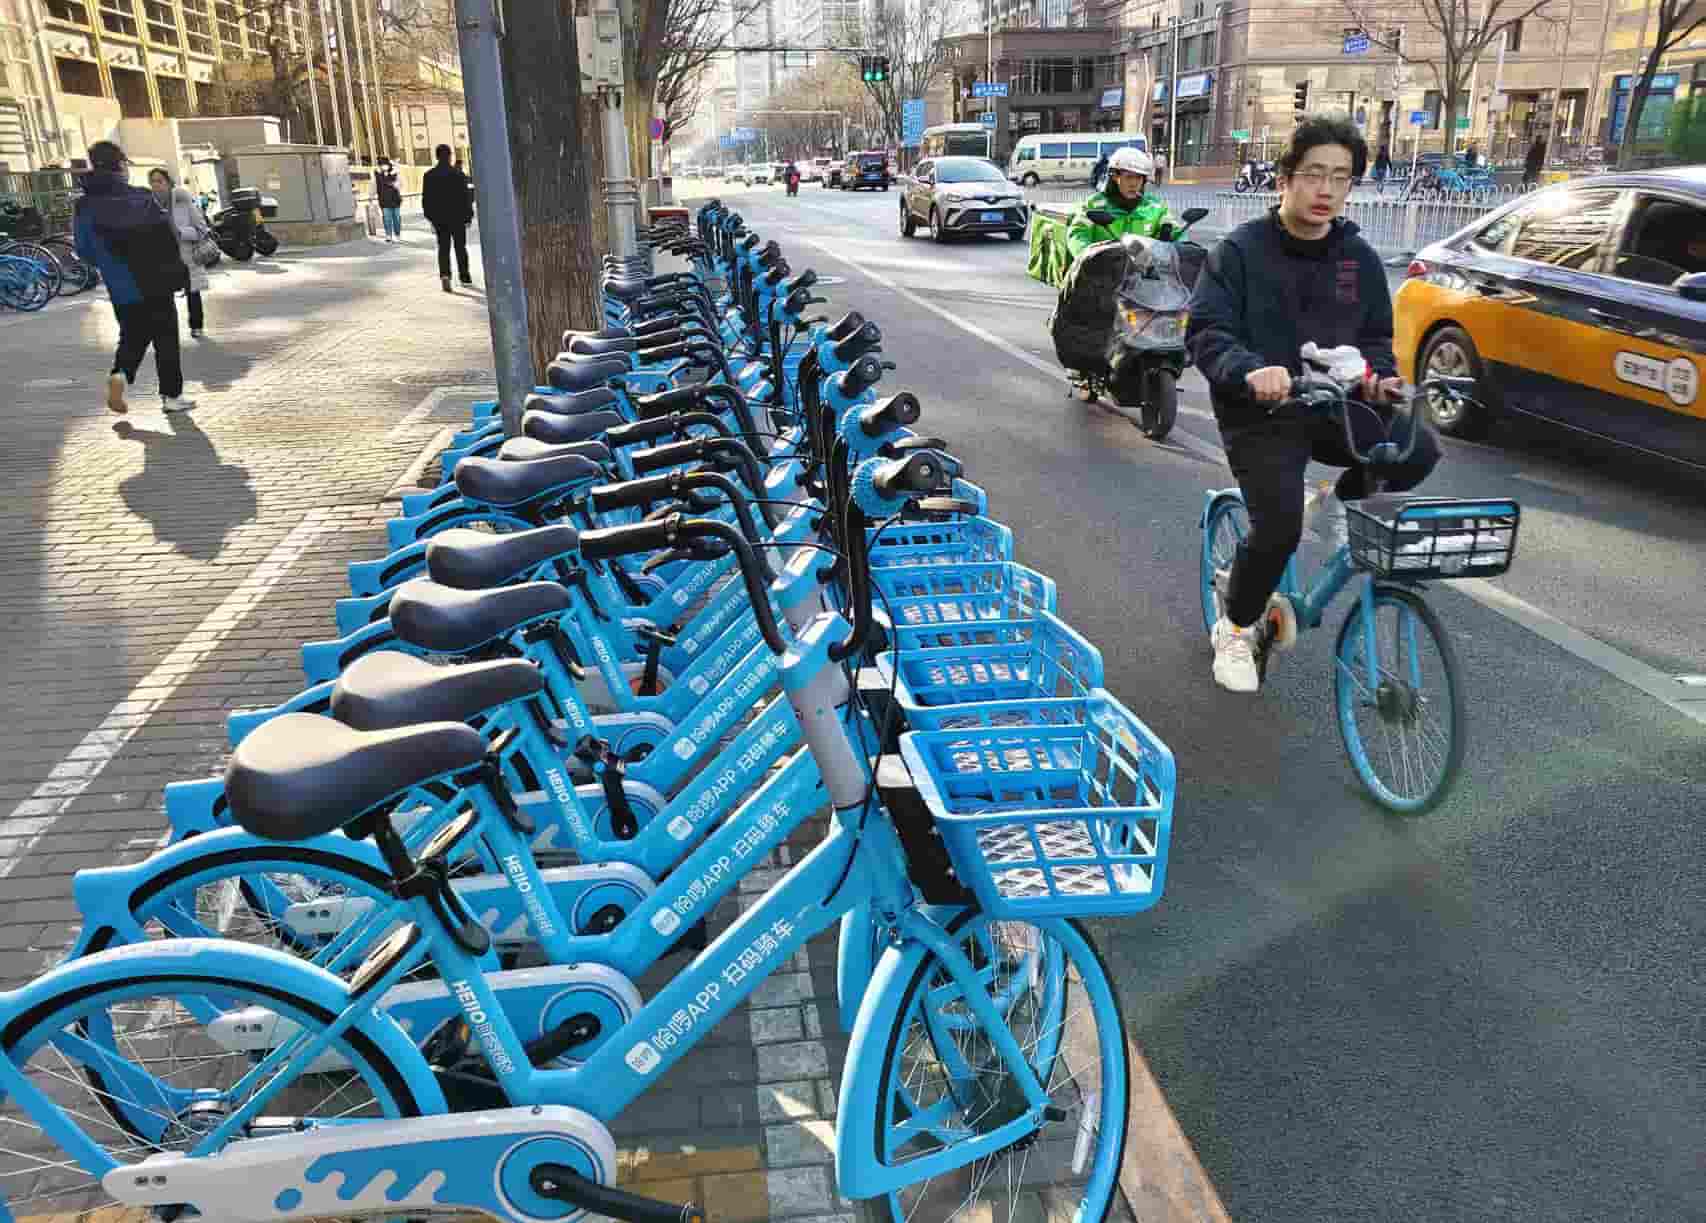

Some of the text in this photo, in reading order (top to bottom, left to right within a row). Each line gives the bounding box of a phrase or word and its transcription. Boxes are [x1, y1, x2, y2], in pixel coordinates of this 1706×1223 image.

[652, 918, 795, 1049] 哈啰APP 扫码骑车
